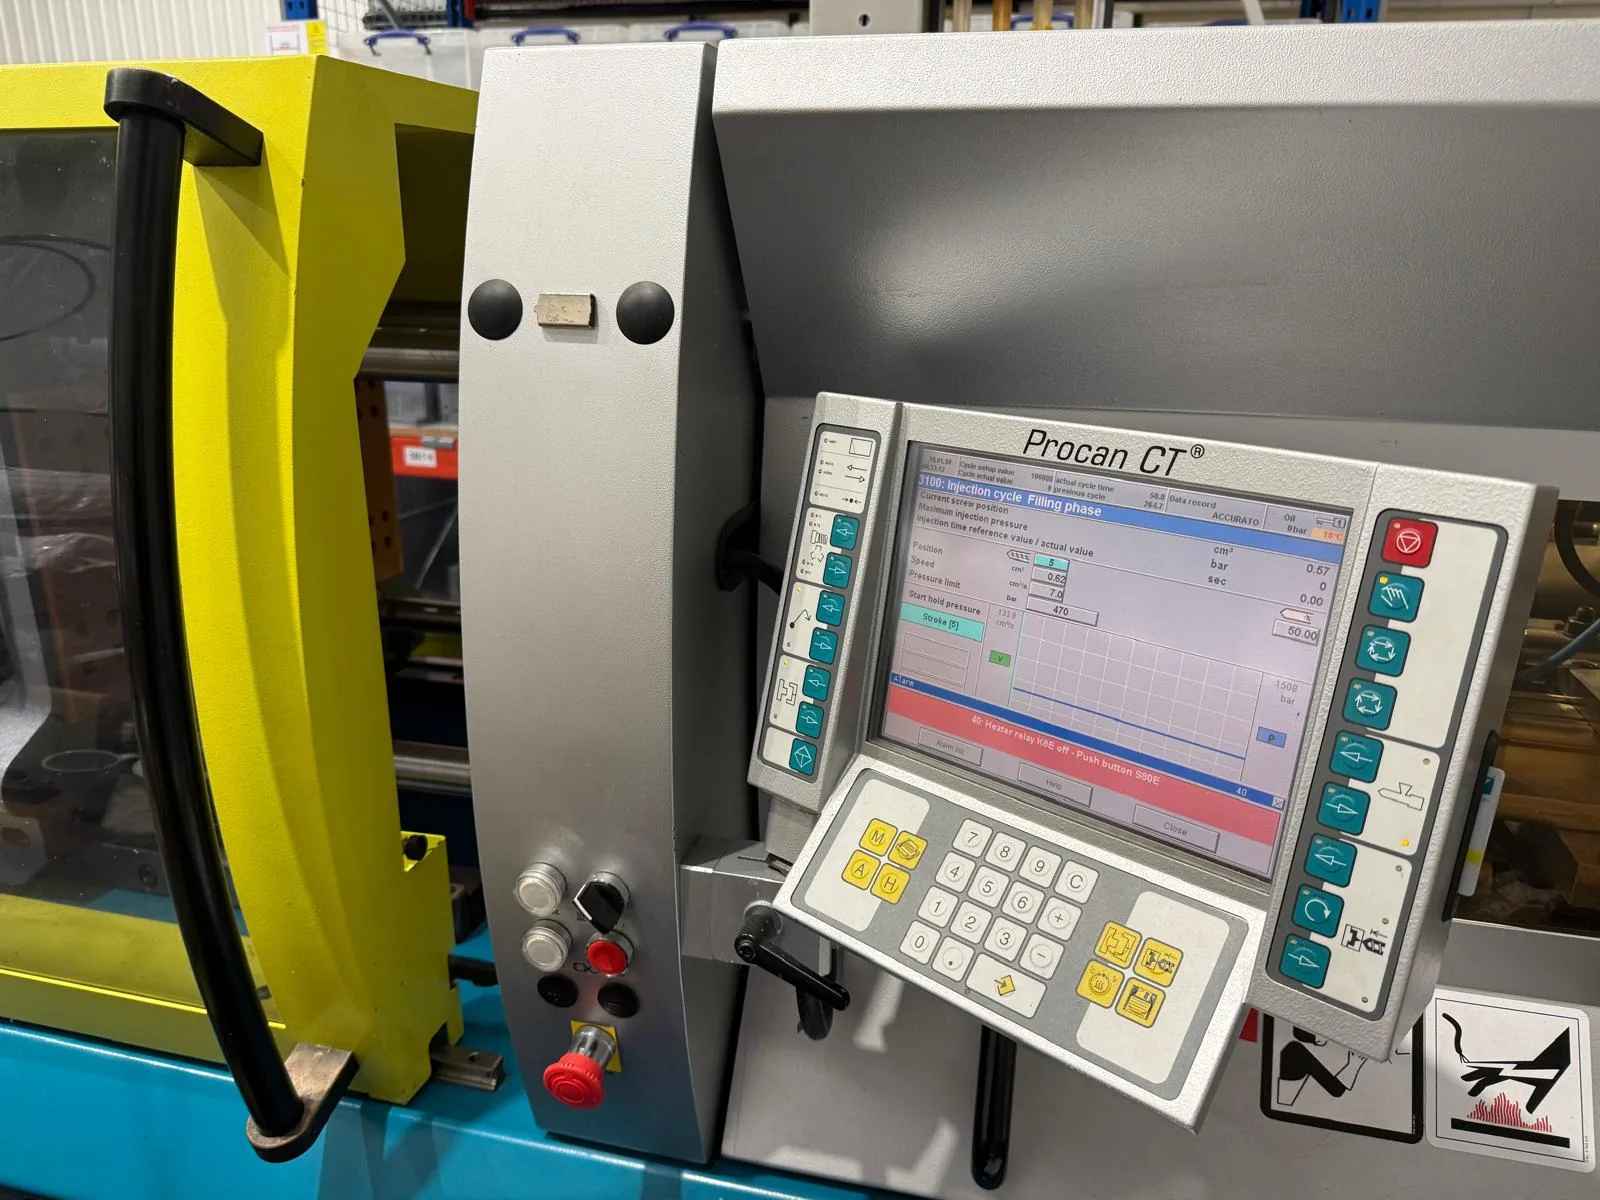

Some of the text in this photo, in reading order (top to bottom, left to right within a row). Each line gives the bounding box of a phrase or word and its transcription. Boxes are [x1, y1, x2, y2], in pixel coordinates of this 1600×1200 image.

[1023, 429, 1129, 470] Procan
[1055, 477, 1115, 492] actual cycle time
[947, 478, 991, 499] Injection
[993, 489, 1023, 504] cycle
[1027, 495, 1062, 512] Filling
[1064, 501, 1103, 518] phase
[1054, 486, 1106, 501] previous cycle
[921, 490, 1009, 515] Current screw position
[1169, 495, 1217, 510] Data record
[919, 502, 1029, 533] Maximum injection pressure
[1211, 511, 1260, 526] ACCURATO
[917, 514, 949, 529] Injection
[950, 520, 967, 532] time
[968, 525, 1009, 540] reference
[1010, 534, 1034, 546] value
[1040, 538, 1068, 552] actual
[1069, 544, 1094, 557] value
[912, 540, 944, 556] Position
[911, 555, 935, 569] Speed
[1048, 558, 1055, 567] 5
[1210, 558, 1229, 572] bar
[908, 569, 961, 589] Pressure limit
[1047, 572, 1066, 585] 0.62
[1207, 575, 1227, 587] sec
[1050, 587, 1064, 599] 7.0
[1319, 581, 1327, 592] 0
[909, 589, 982, 617] Start hold pressure
[1300, 593, 1324, 607] 0.00
[1052, 605, 1069, 617] 470
[922, 612, 947, 627] Stroke
[1288, 626, 1319, 642] 50.00
[1280, 694, 1296, 705] bar
[985, 719, 1013, 736] Heater
[1014, 729, 1035, 746] relay
[1057, 744, 1070, 755] off
[1076, 750, 1101, 767] Push
[1102, 758, 1133, 777] button
[1164, 821, 1188, 837] Close
[871, 831, 885, 845] M
[967, 831, 1084, 890] 7 8 9 C
[853, 862, 898, 892] A H
[949, 865, 961, 879] 4
[982, 880, 994, 894] 5
[1017, 896, 1028, 910] 6
[934, 901, 943, 914] 1
[964, 915, 977, 930] 2
[999, 932, 1011, 947] 3
[914, 935, 925, 949] 0
